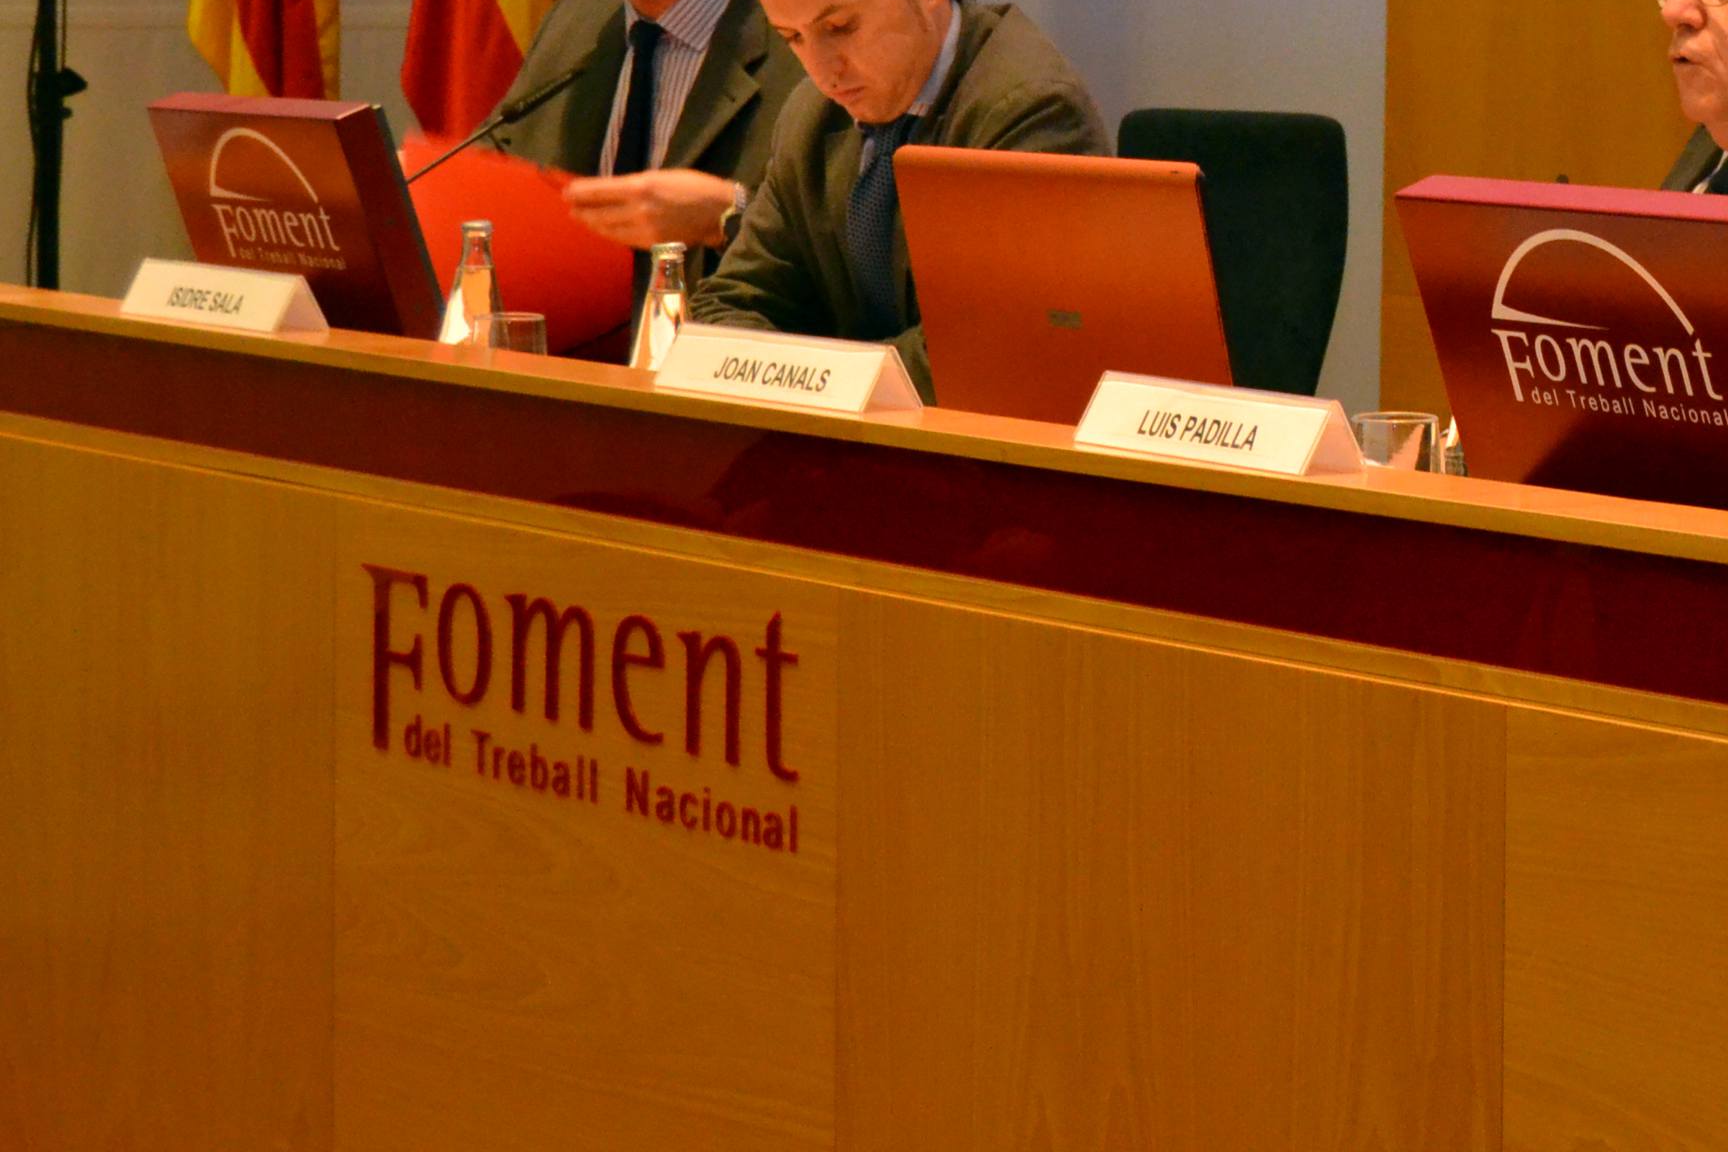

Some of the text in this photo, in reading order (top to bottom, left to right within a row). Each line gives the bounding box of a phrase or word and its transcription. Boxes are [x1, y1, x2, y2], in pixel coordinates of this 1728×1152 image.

[211, 204, 341, 258] Foment
[167, 285, 245, 315] ISIDRE SALA
[713, 356, 831, 392] JOAN CANALS
[1491, 329, 1724, 401] Foment
[1531, 386, 1559, 406] del
[1566, 389, 1635, 416] Treball
[1137, 409, 1258, 451] LUIS PADILLA
[361, 563, 799, 784] Foment
[404, 714, 799, 854] del Treball Nacional
